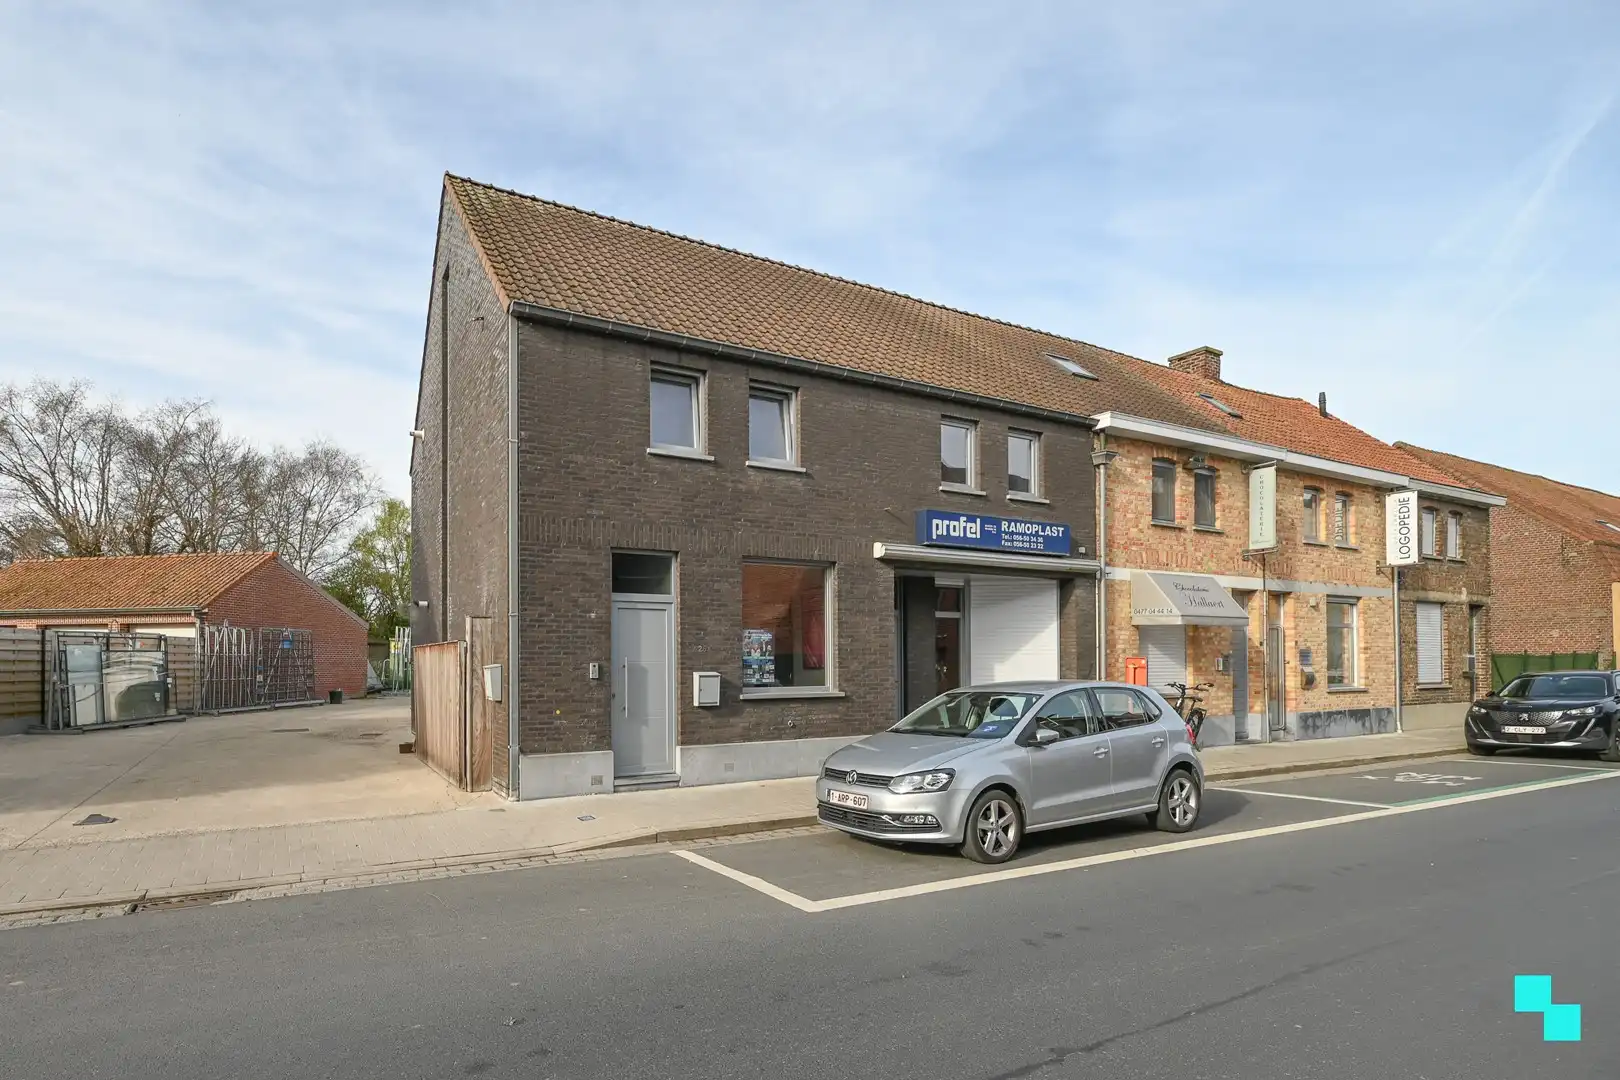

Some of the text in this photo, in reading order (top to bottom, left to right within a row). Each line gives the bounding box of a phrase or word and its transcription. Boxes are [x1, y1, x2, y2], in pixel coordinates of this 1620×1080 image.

[932, 516, 981, 540] profel
[1001, 520, 1065, 538] RAMOPLAST
[1398, 496, 1411, 560] LOGOPEDIE
